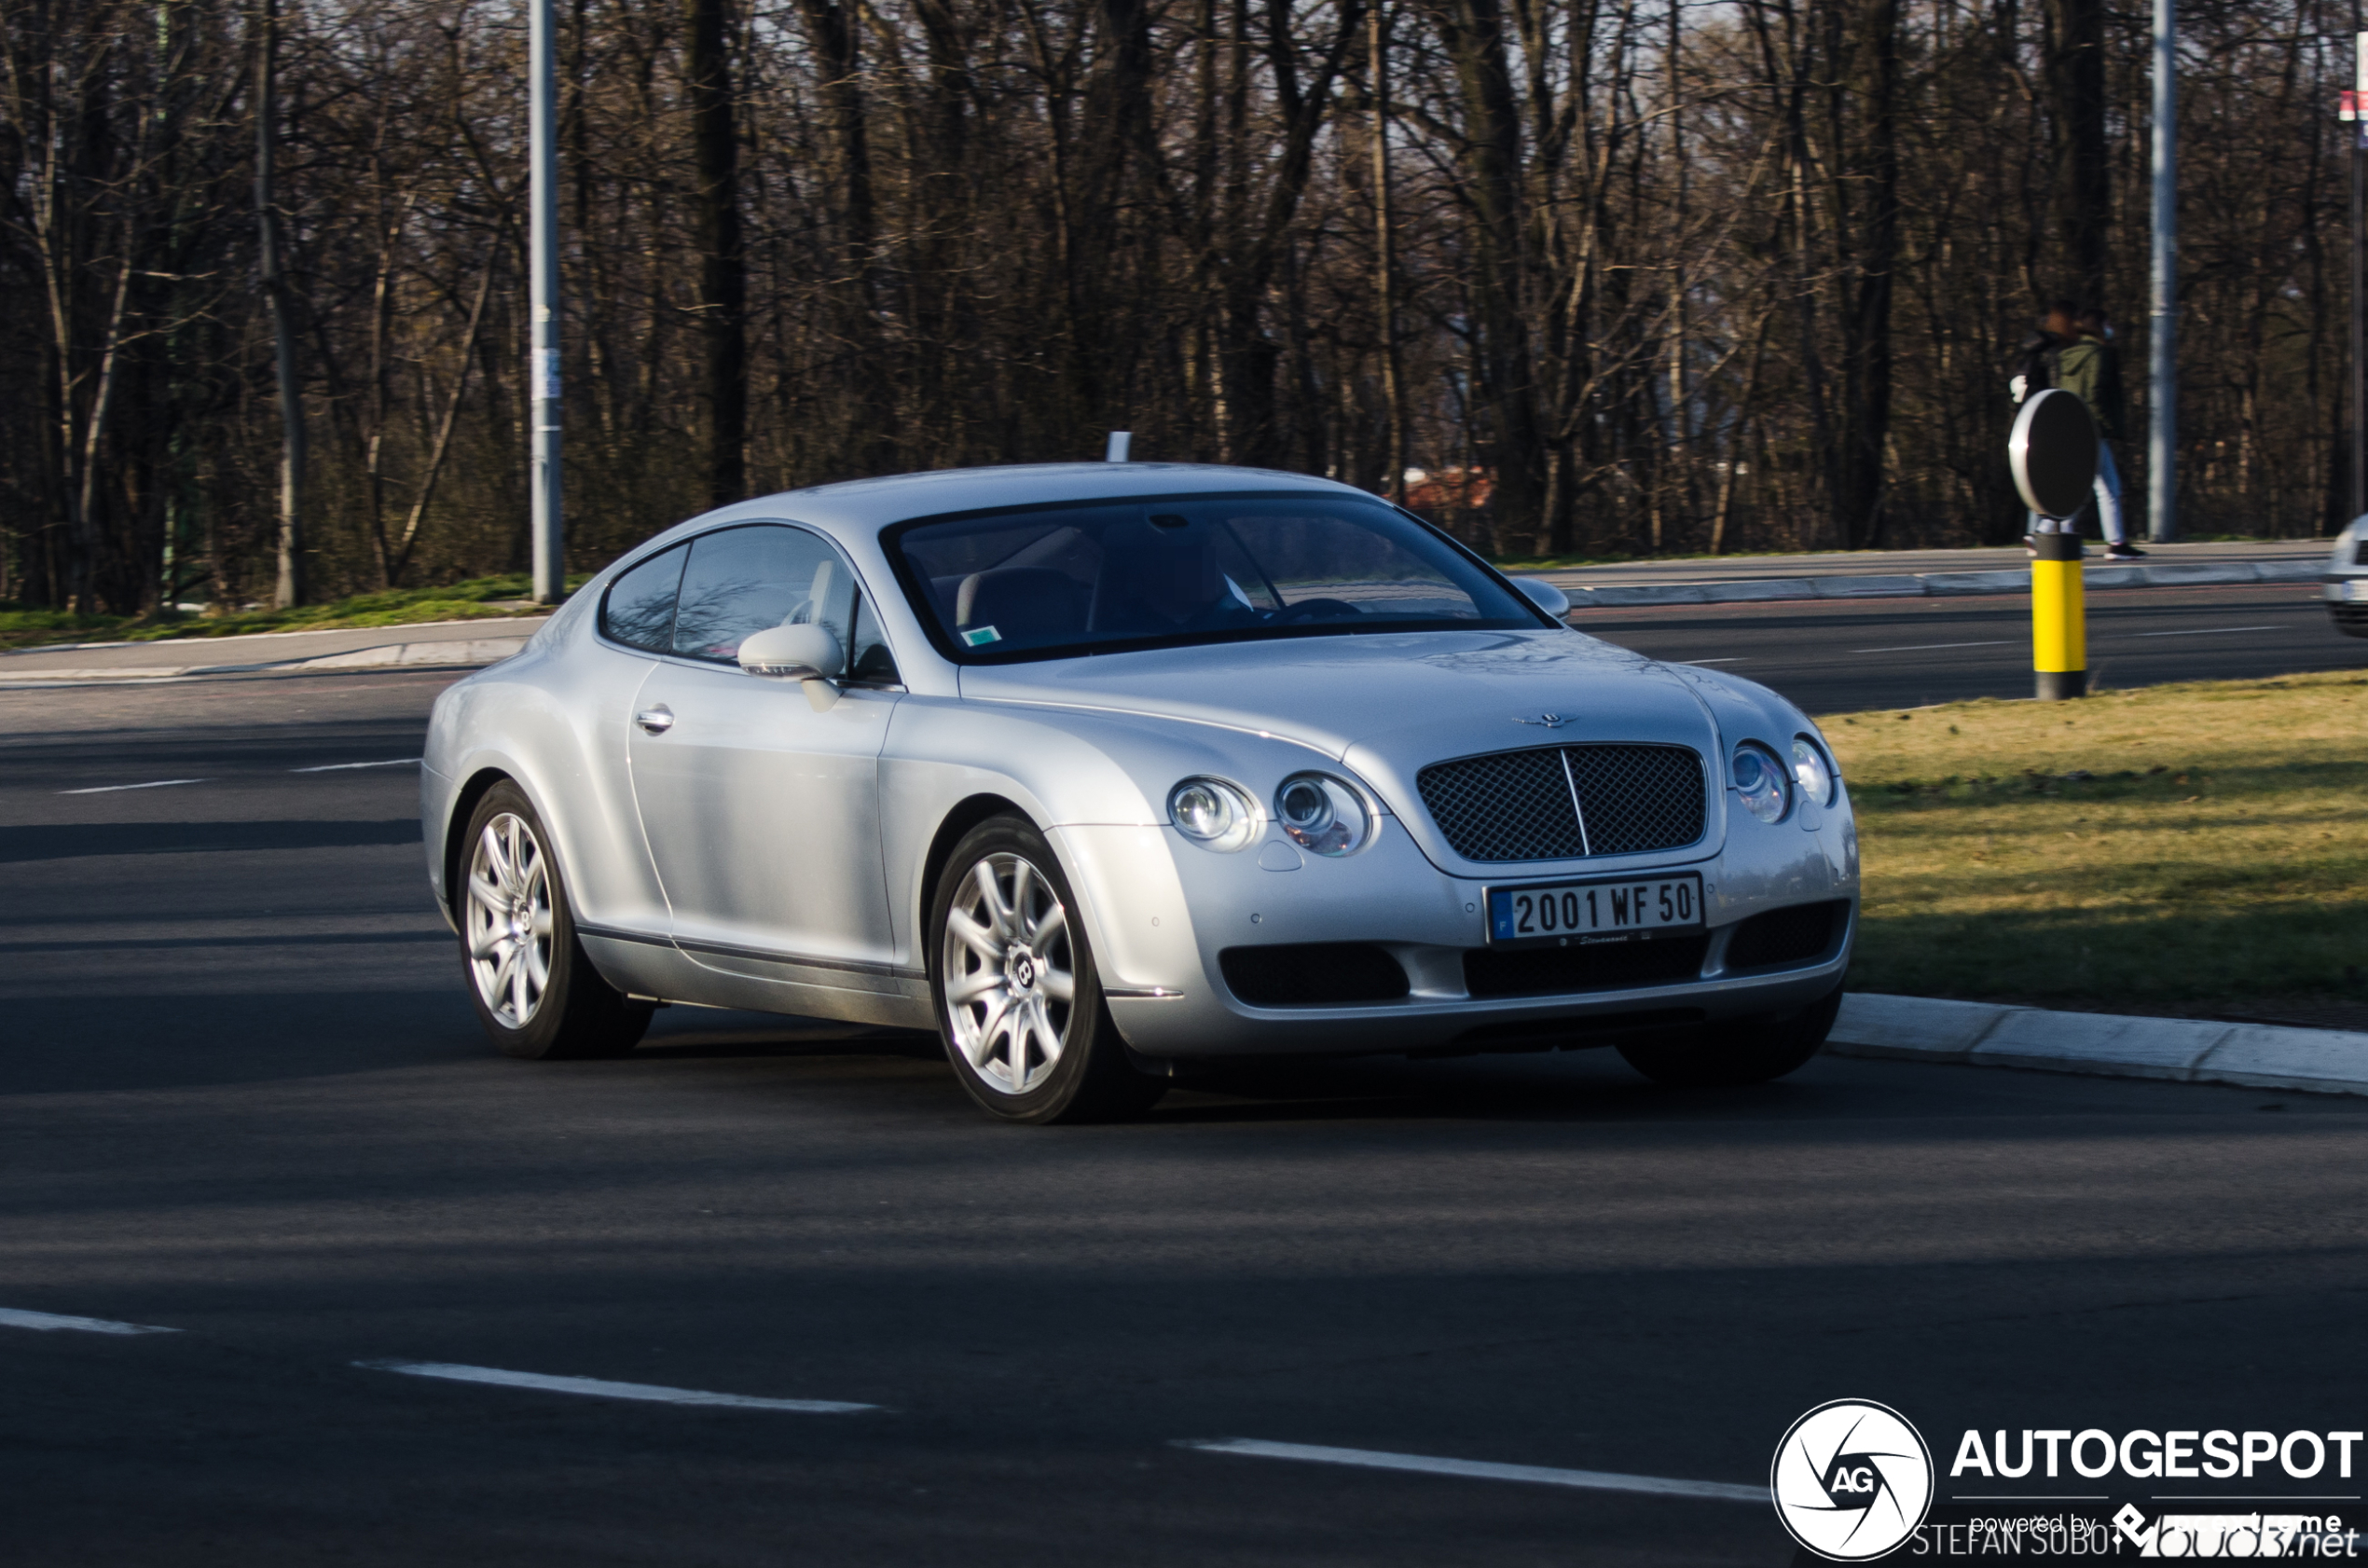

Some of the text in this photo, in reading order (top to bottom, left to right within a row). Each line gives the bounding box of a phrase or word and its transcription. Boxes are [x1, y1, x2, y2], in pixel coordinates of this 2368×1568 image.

[1516, 883, 1692, 933] 2001 WF 50
[1499, 920, 1507, 931] F
